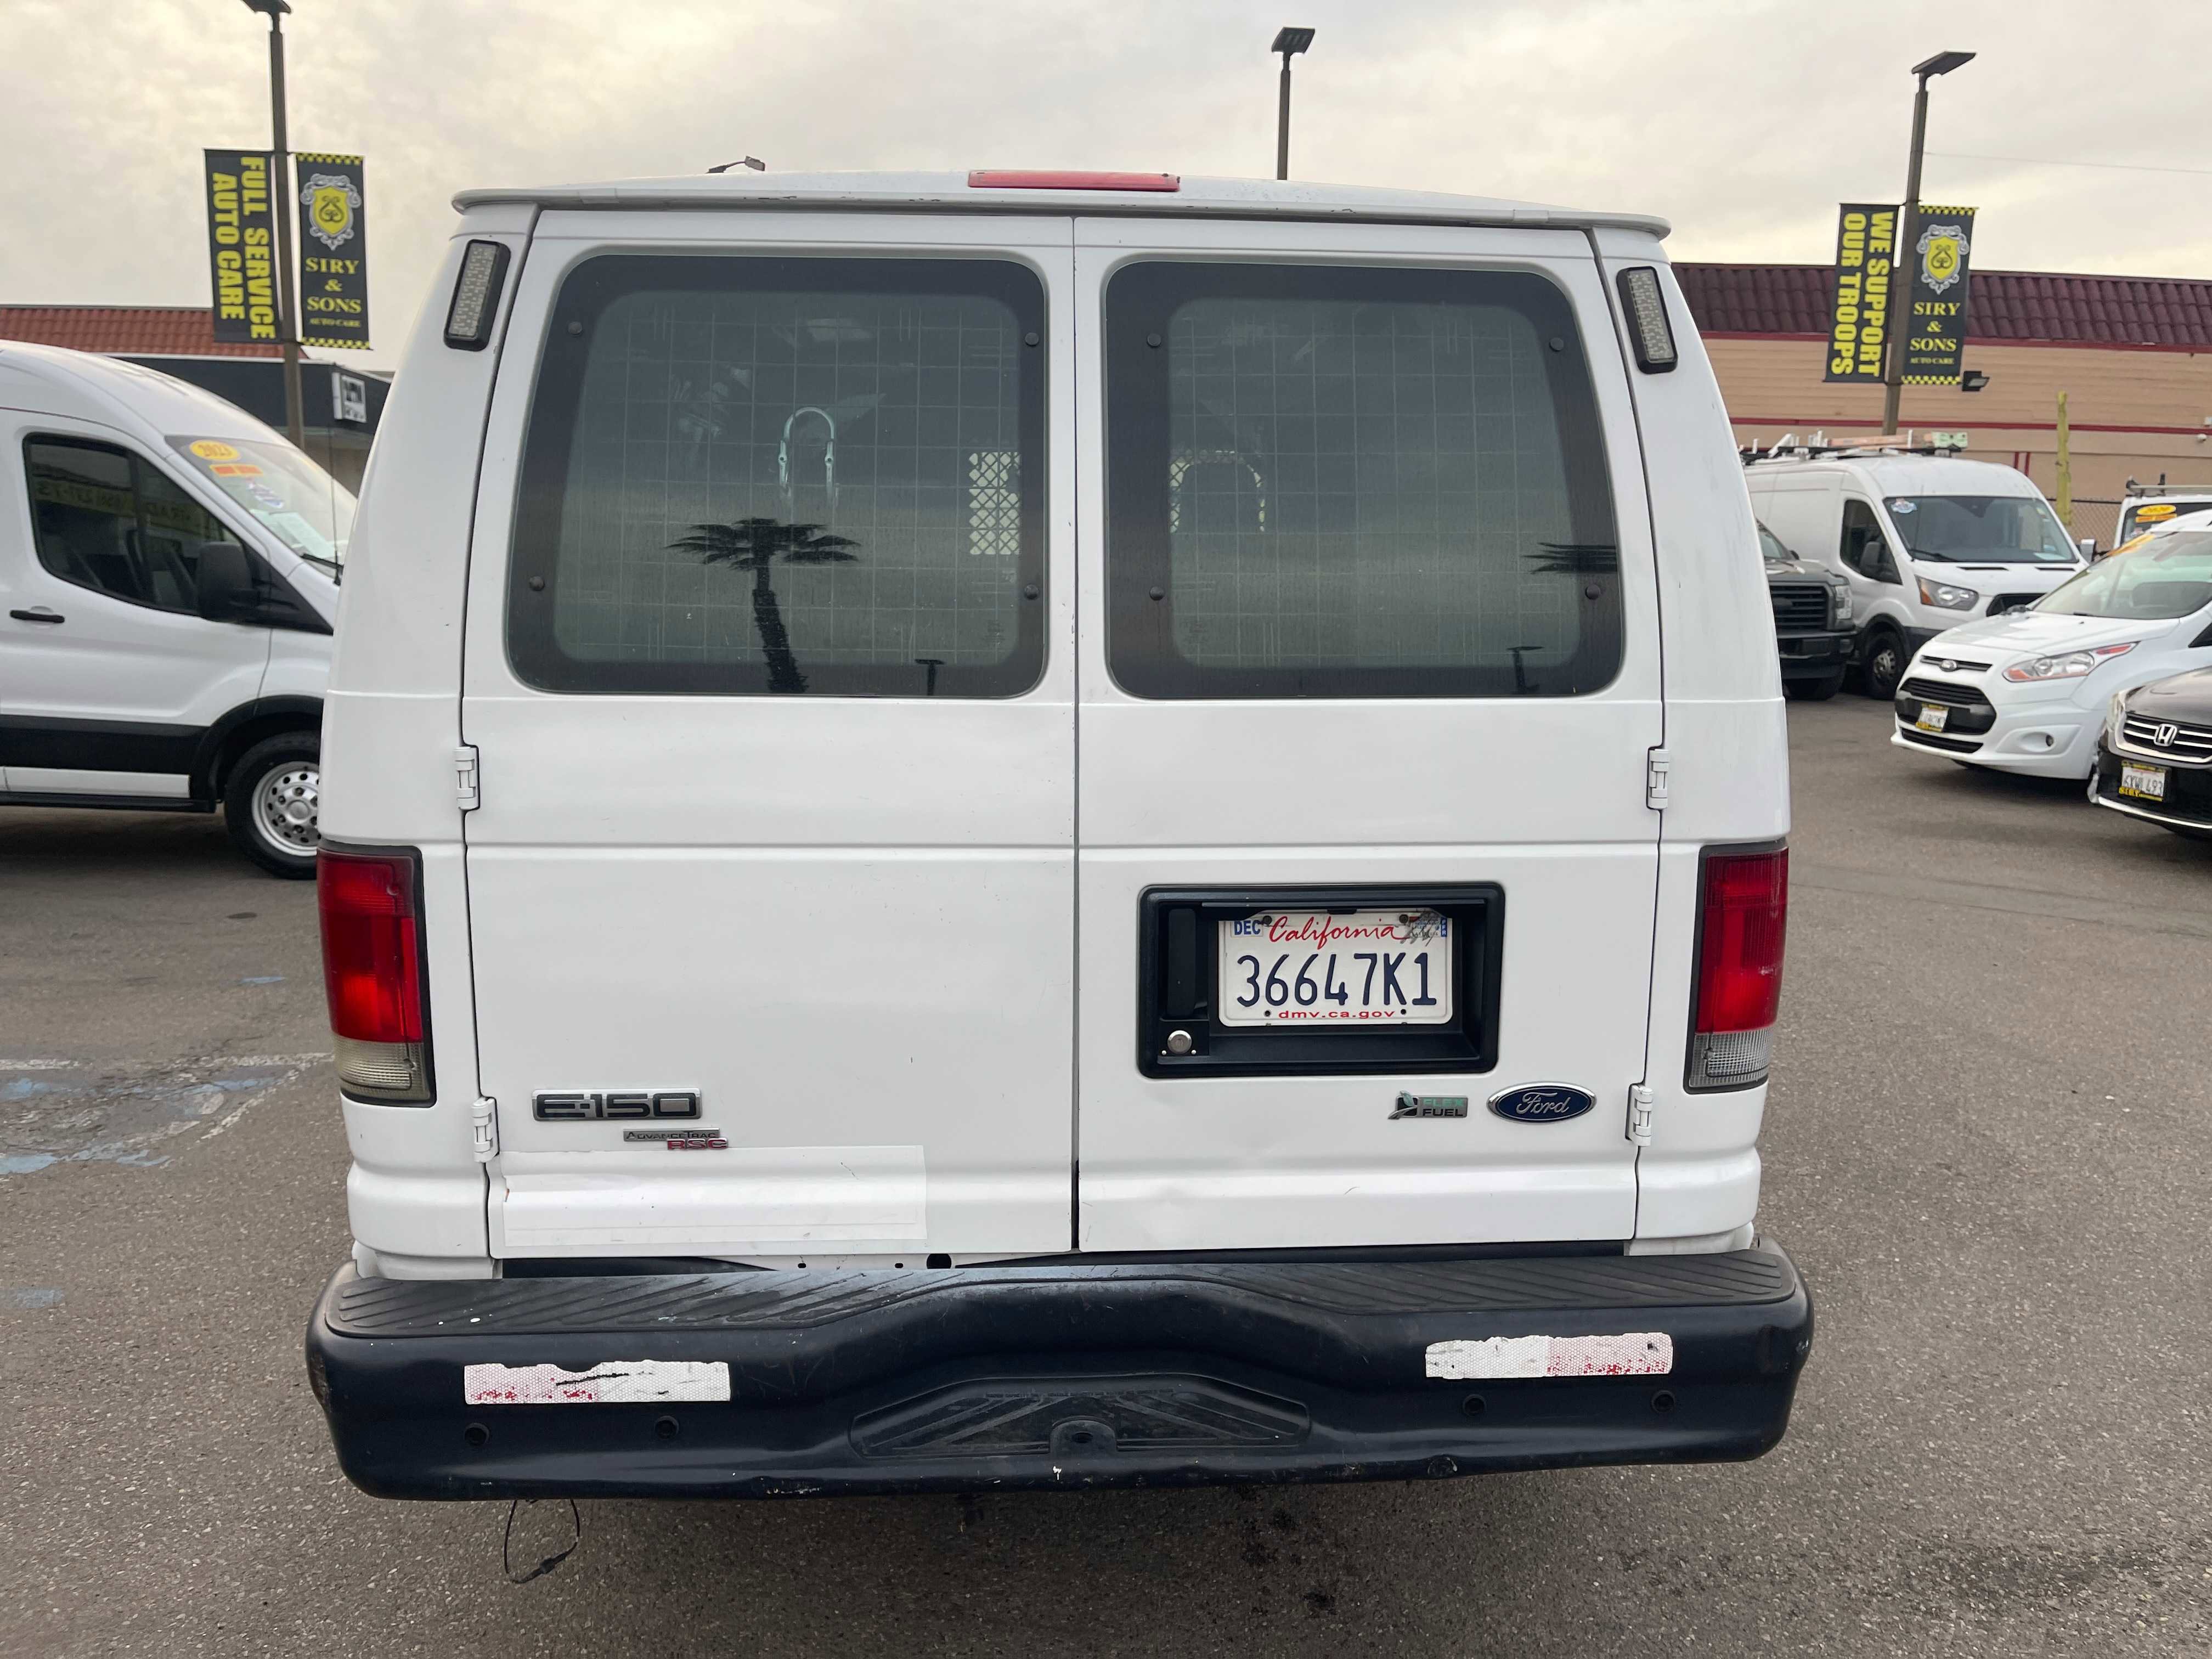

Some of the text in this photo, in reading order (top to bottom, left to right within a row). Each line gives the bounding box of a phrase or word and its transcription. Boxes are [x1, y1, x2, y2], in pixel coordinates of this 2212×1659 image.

[212, 172, 245, 319] AUTO CARE
[240, 156, 276, 339] FULL SERVICE
[305, 257, 359, 274] SIRY
[324, 279, 342, 292] &
[1831, 213, 1866, 375] OUR TROOPS
[1858, 211, 1894, 377] WE SUPPORT
[307, 296, 362, 313] SONS
[1914, 302, 1960, 316] SIRY
[335, 319, 360, 328] CARE
[1926, 320, 1942, 332] &
[1910, 338, 1957, 352] SONS
[1234, 920, 1261, 935] DEC
[1269, 916, 1409, 950] California
[1237, 952, 1437, 1007] 36647K1
[1278, 1010, 1395, 1019] dmv.ca.gov
[1423, 1098, 1464, 1106] FLEX
[1516, 1092, 1571, 1115] Ford
[667, 1138, 727, 1150] RSC
